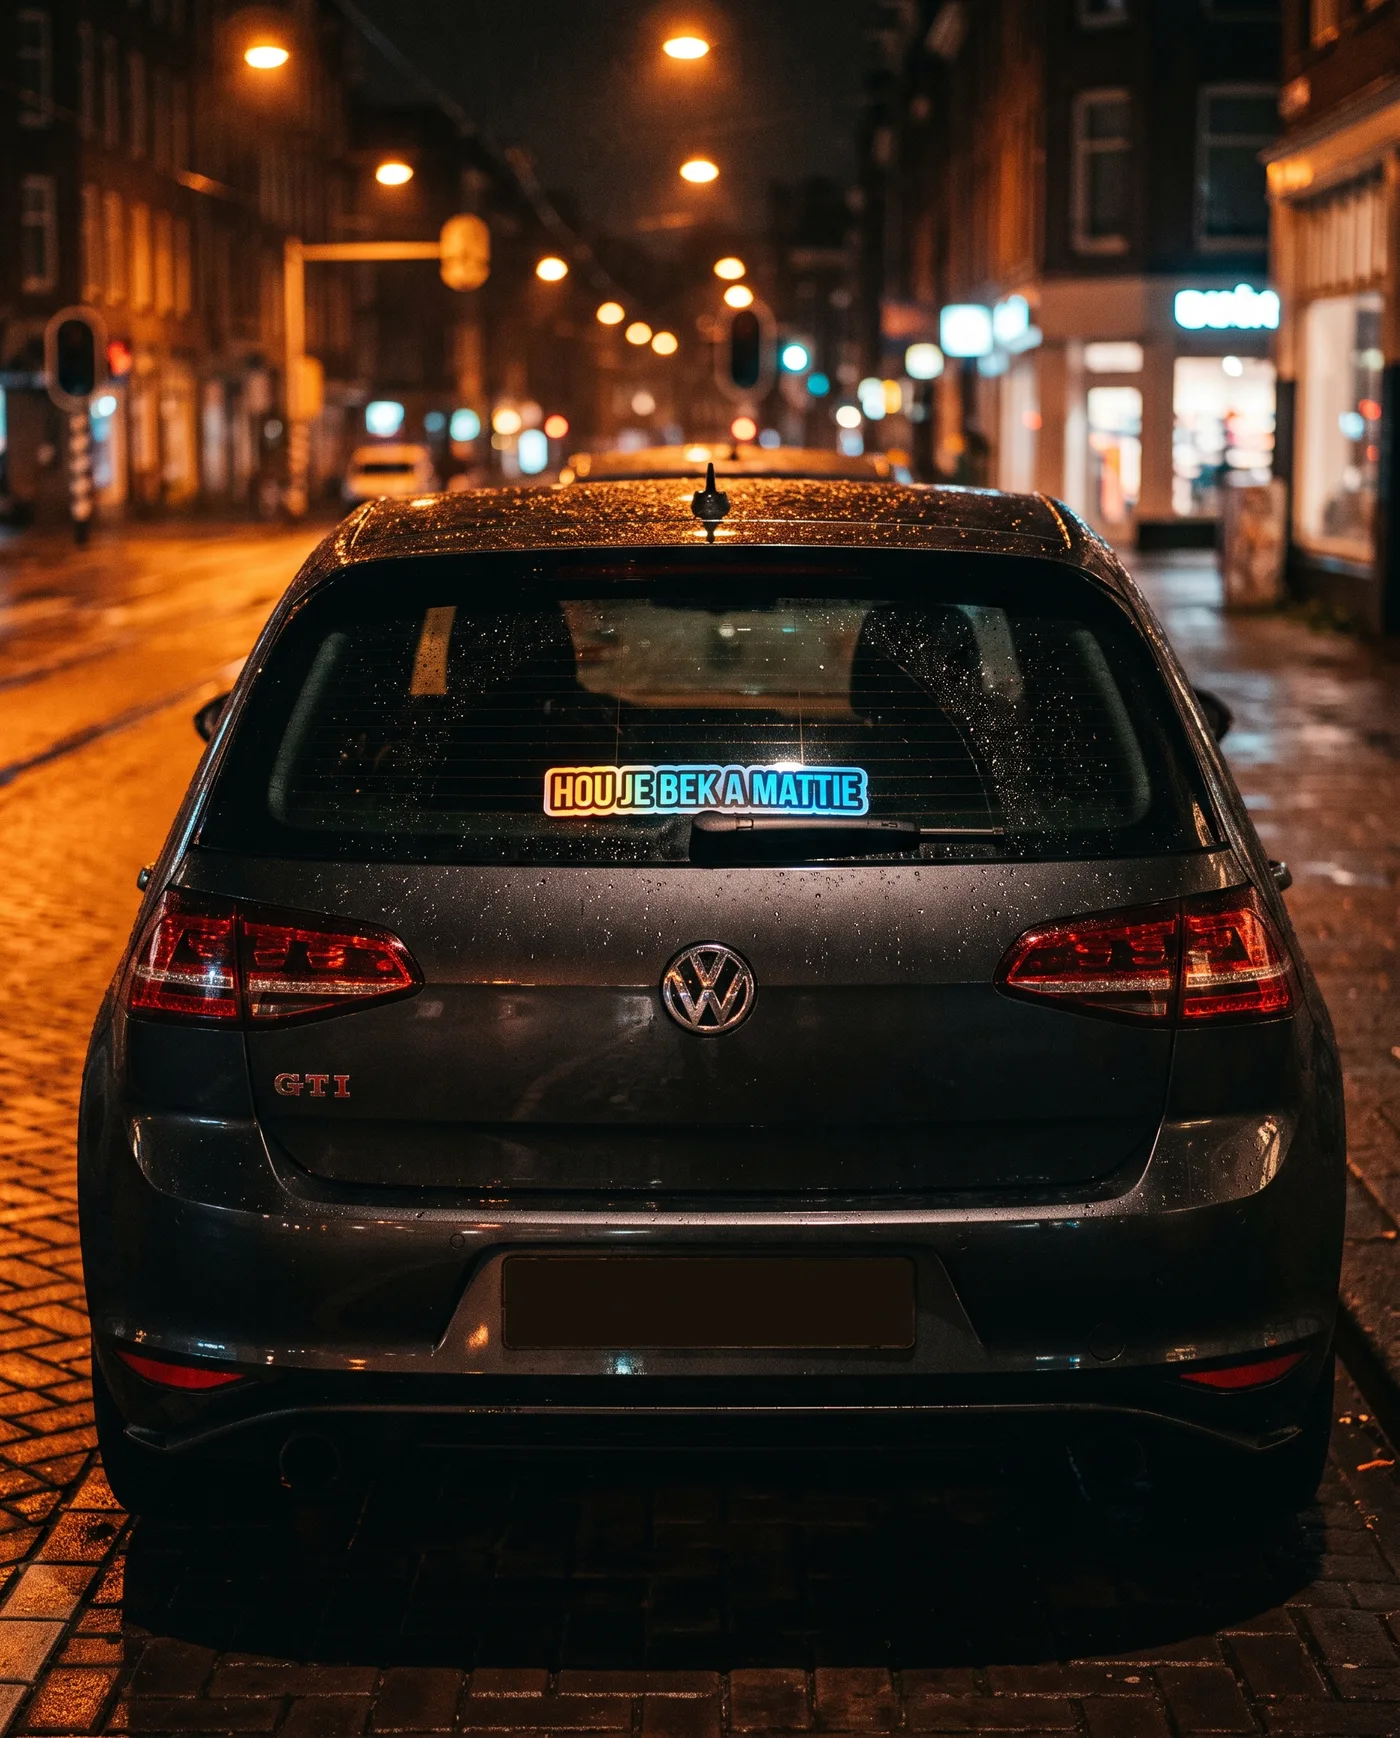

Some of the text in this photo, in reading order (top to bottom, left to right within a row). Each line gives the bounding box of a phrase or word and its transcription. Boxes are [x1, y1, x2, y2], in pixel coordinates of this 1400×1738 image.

[554, 773, 859, 807] HOU JE BEK A MATTIE
[274, 1072, 351, 1098] GTI
